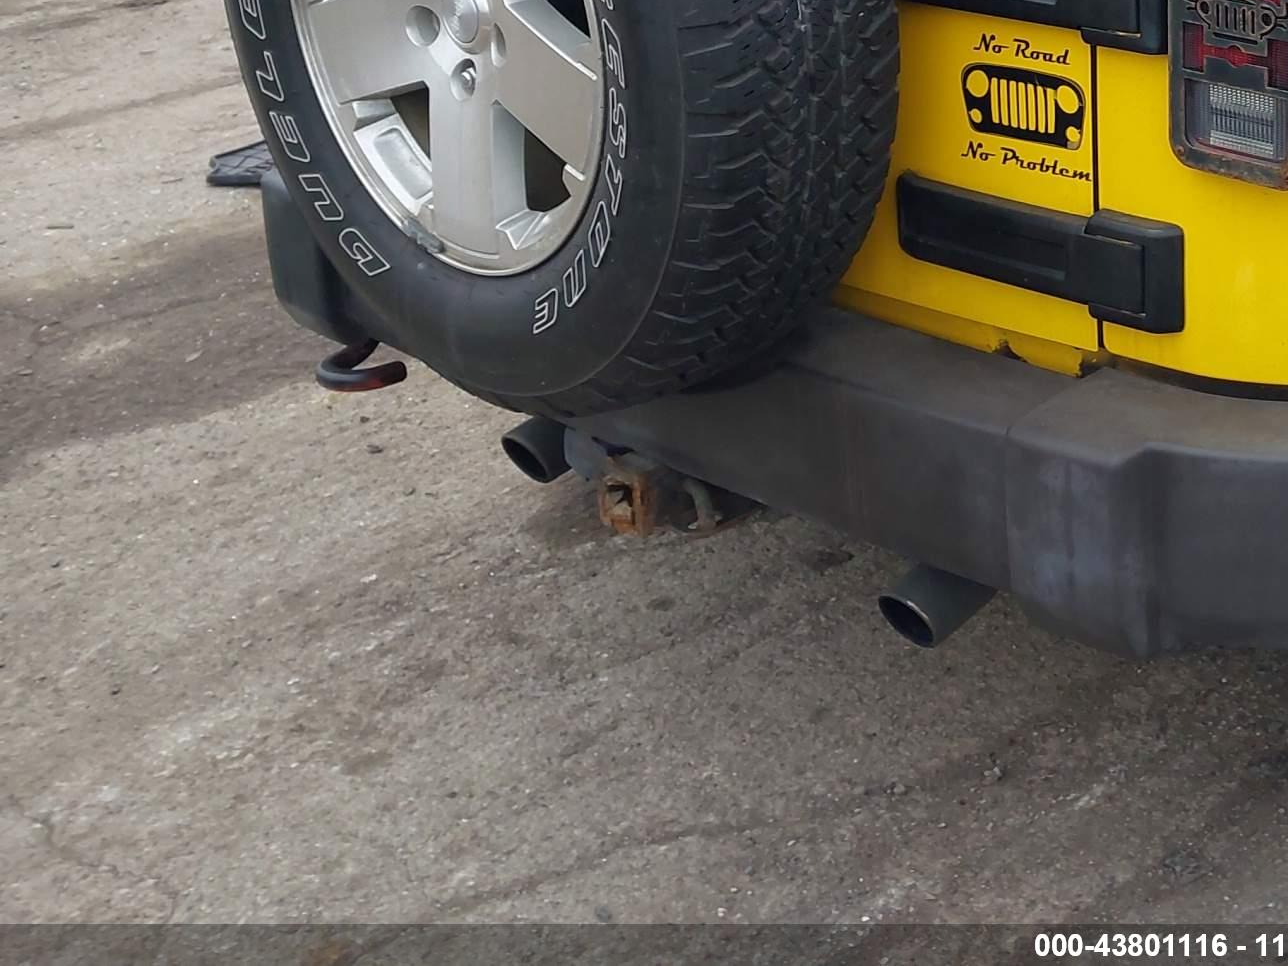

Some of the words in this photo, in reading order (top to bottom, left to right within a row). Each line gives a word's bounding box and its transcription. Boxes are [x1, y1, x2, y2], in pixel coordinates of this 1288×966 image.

[973, 33, 1009, 54] No
[1013, 38, 1071, 66] Road
[961, 140, 997, 162] No
[1000, 146, 1092, 182] Problem
